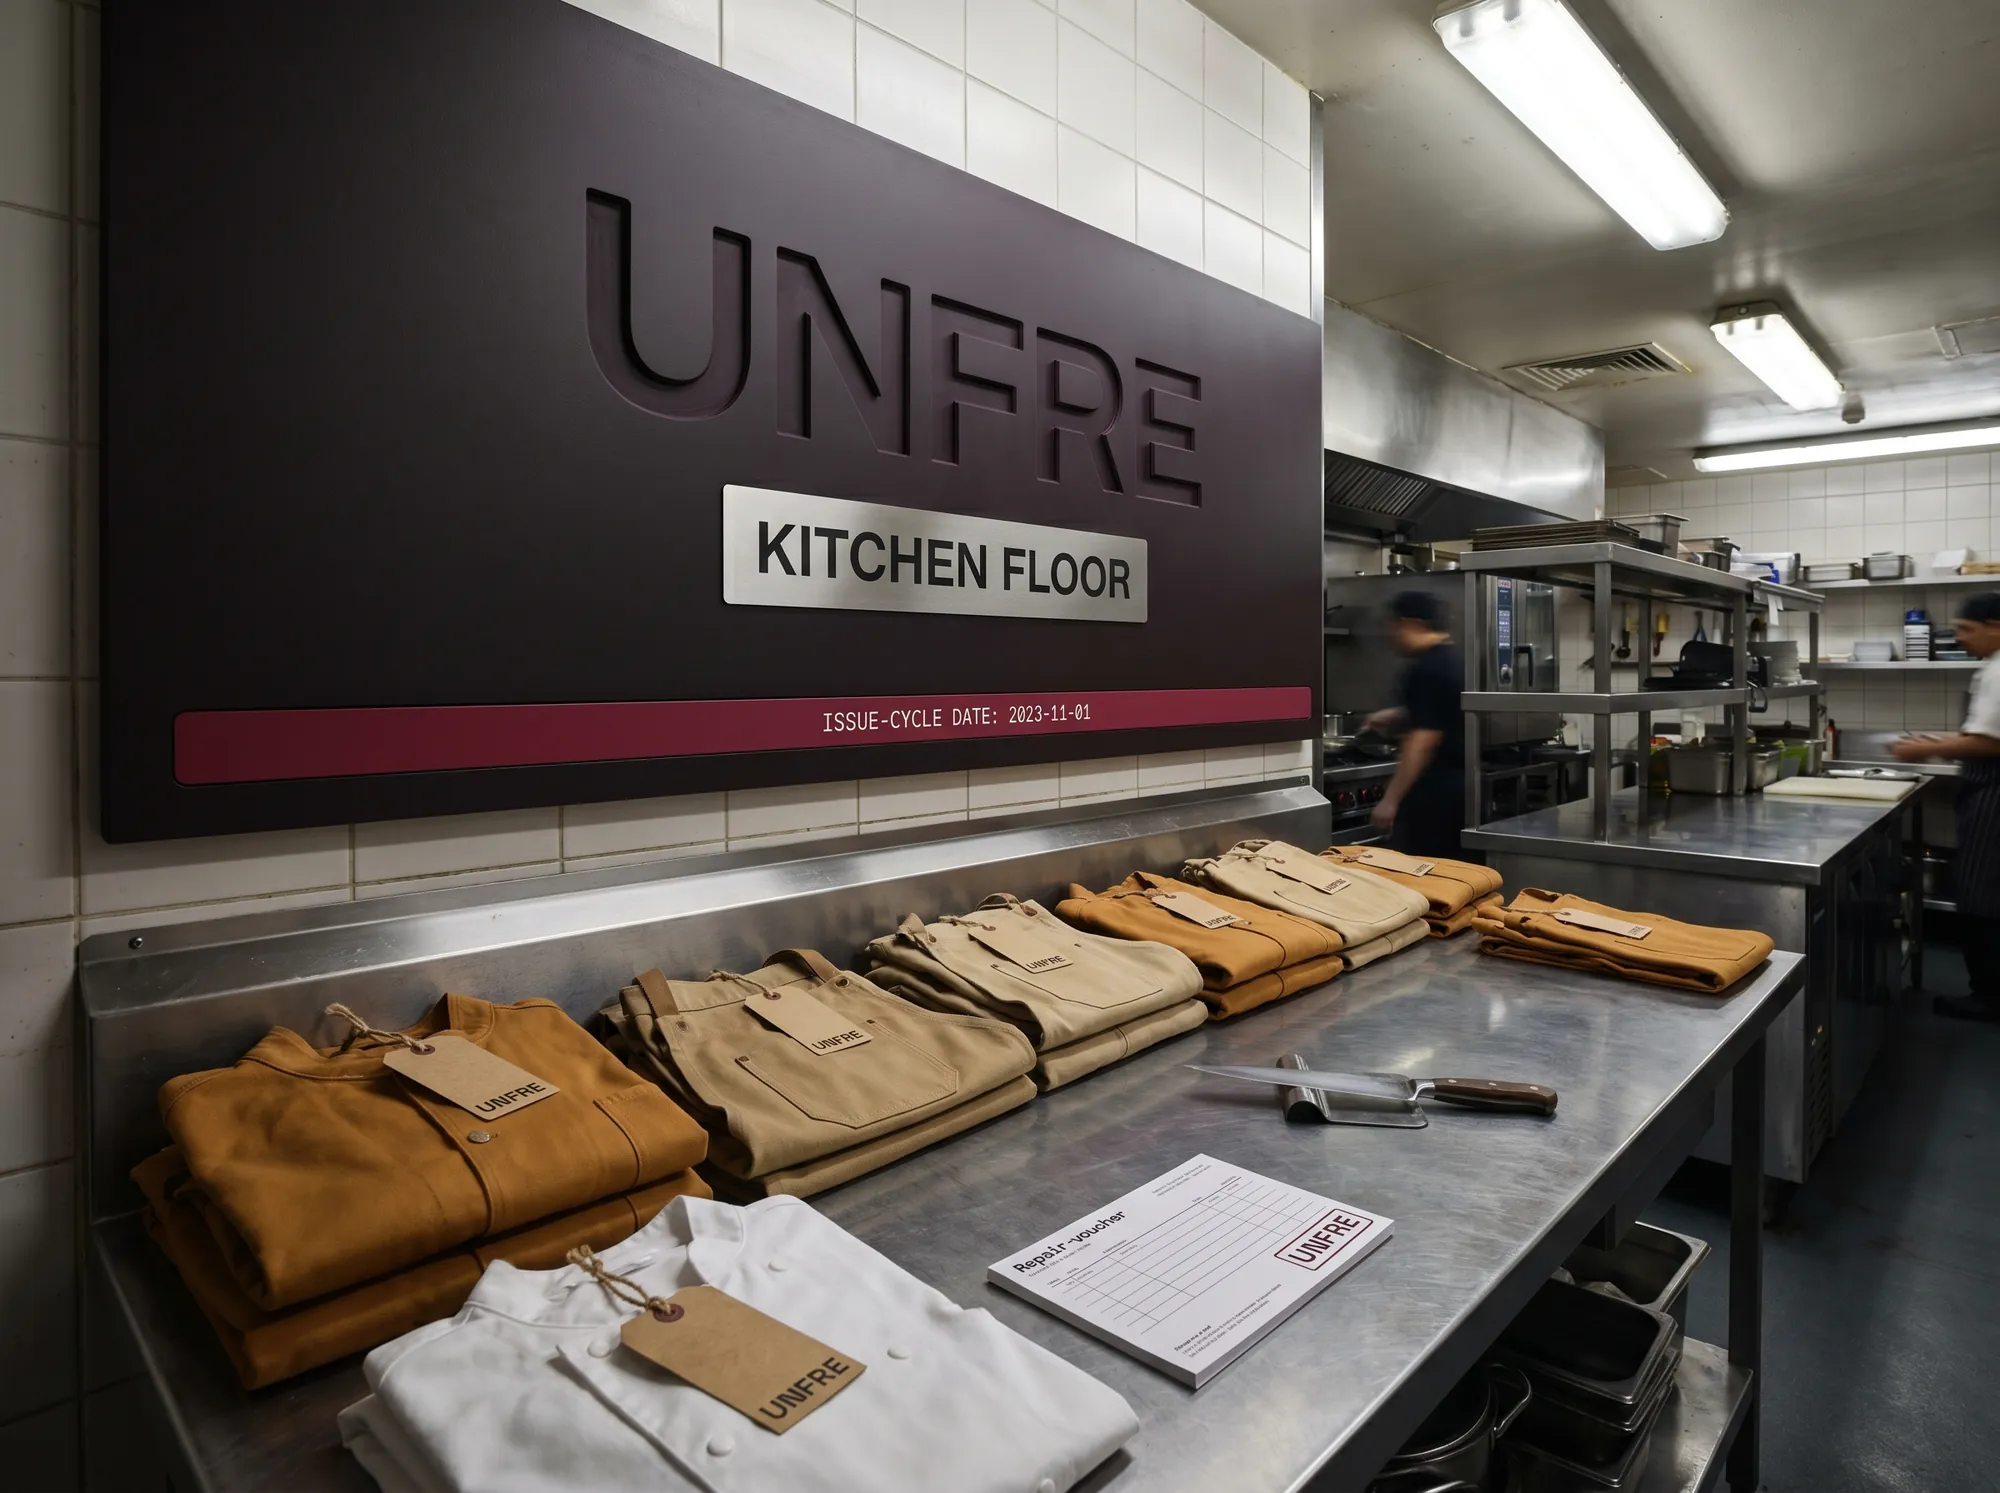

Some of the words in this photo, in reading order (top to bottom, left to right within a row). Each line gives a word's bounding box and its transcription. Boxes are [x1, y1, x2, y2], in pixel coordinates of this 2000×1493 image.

[585, 187, 1204, 508] UNFRE
[757, 521, 988, 590] KITCHEN
[1003, 547, 1131, 600] FLOOR
[822, 708, 942, 732] ISSUE-CYCLE
[952, 706, 998, 726] DATE:
[1008, 703, 1091, 724] 2023-11-01
[475, 1082, 547, 1113] UNFRE
[1013, 1210, 1126, 1273] Repair-voucher
[1288, 1214, 1361, 1265] UNFRE
[759, 1357, 851, 1420] UNFRE
